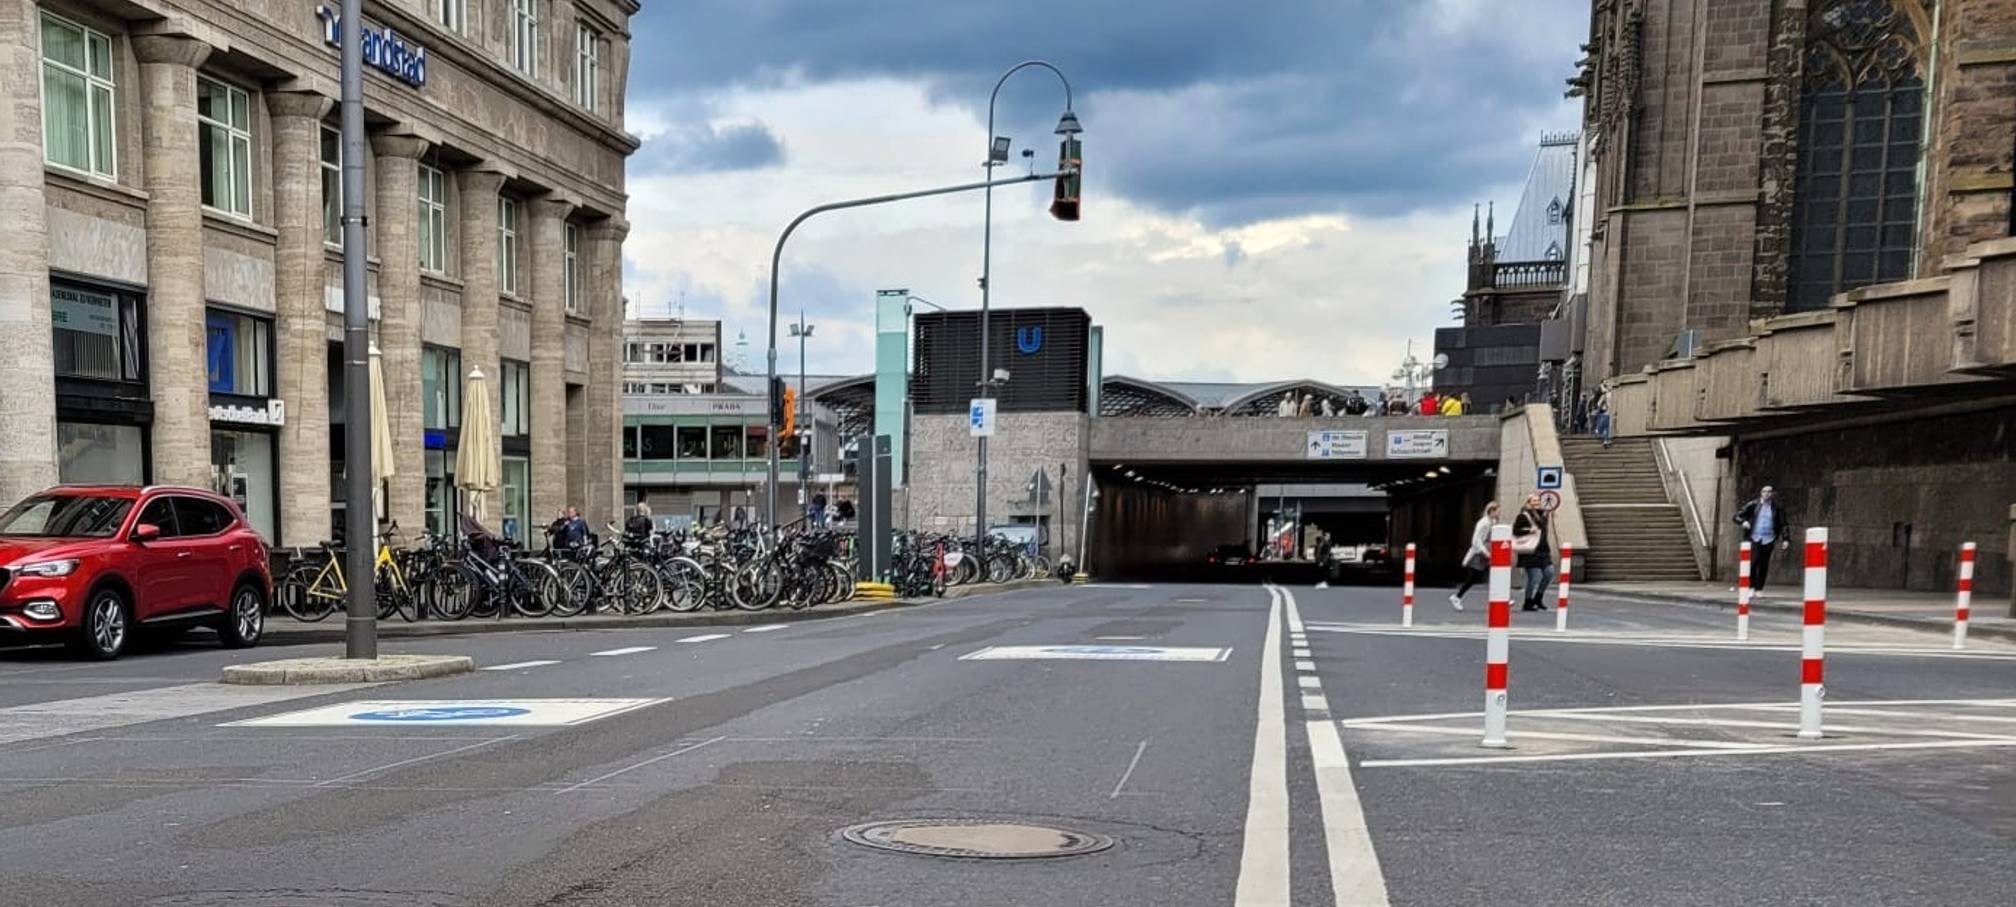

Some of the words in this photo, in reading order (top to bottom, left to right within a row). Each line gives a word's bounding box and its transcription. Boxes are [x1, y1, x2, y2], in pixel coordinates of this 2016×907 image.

[361, 26, 425, 87] andstad
[1017, 325, 1042, 353] U
[712, 402, 741, 411] PRADA
